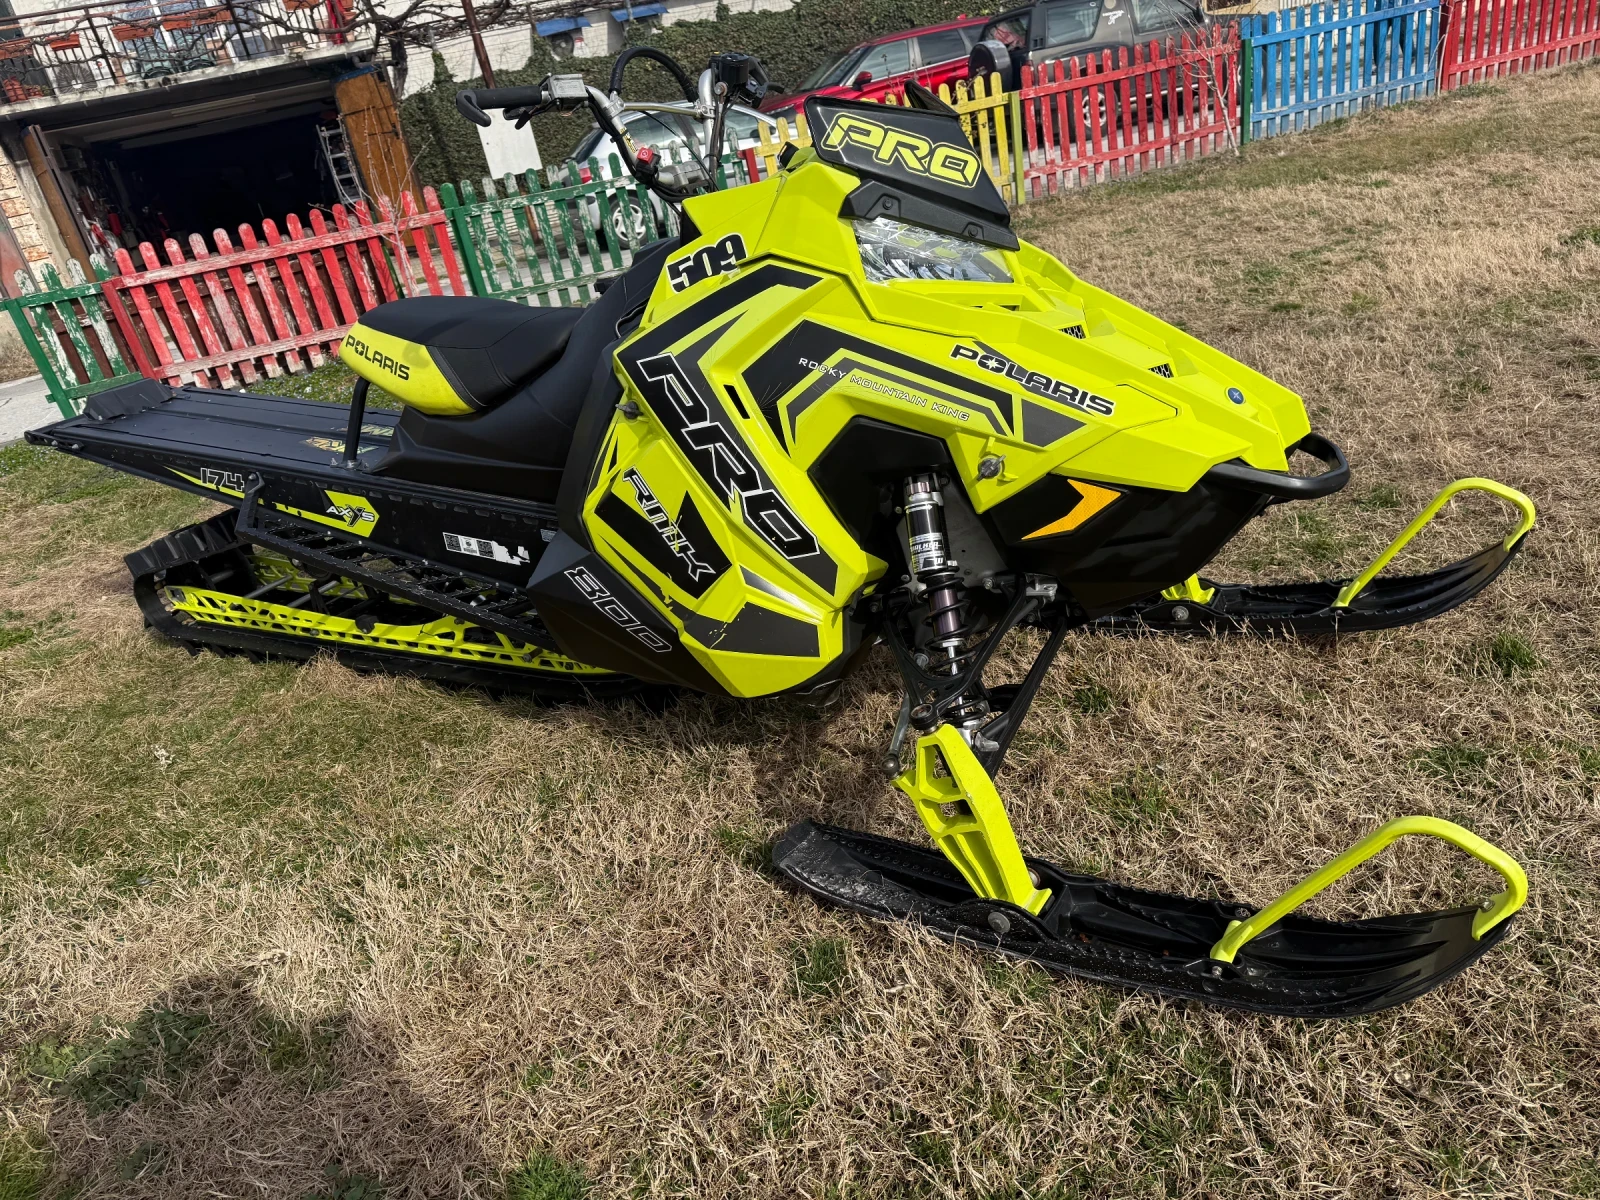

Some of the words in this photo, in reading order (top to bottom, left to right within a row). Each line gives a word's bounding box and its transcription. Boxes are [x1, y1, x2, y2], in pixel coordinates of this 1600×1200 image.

[821, 113, 982, 188] PRO
[666, 232, 748, 294] 509
[345, 334, 410, 381] POLARIS
[798, 357, 847, 379] ROCKY
[850, 375, 927, 408] MOUNTAIN
[931, 402, 970, 421] KING
[950, 344, 1115, 416] POLARIS
[200, 467, 244, 492] 174
[636, 351, 820, 559] PRO
[326, 504, 375, 527] AXYS
[622, 465, 716, 582] RMK
[563, 566, 673, 653] 800
